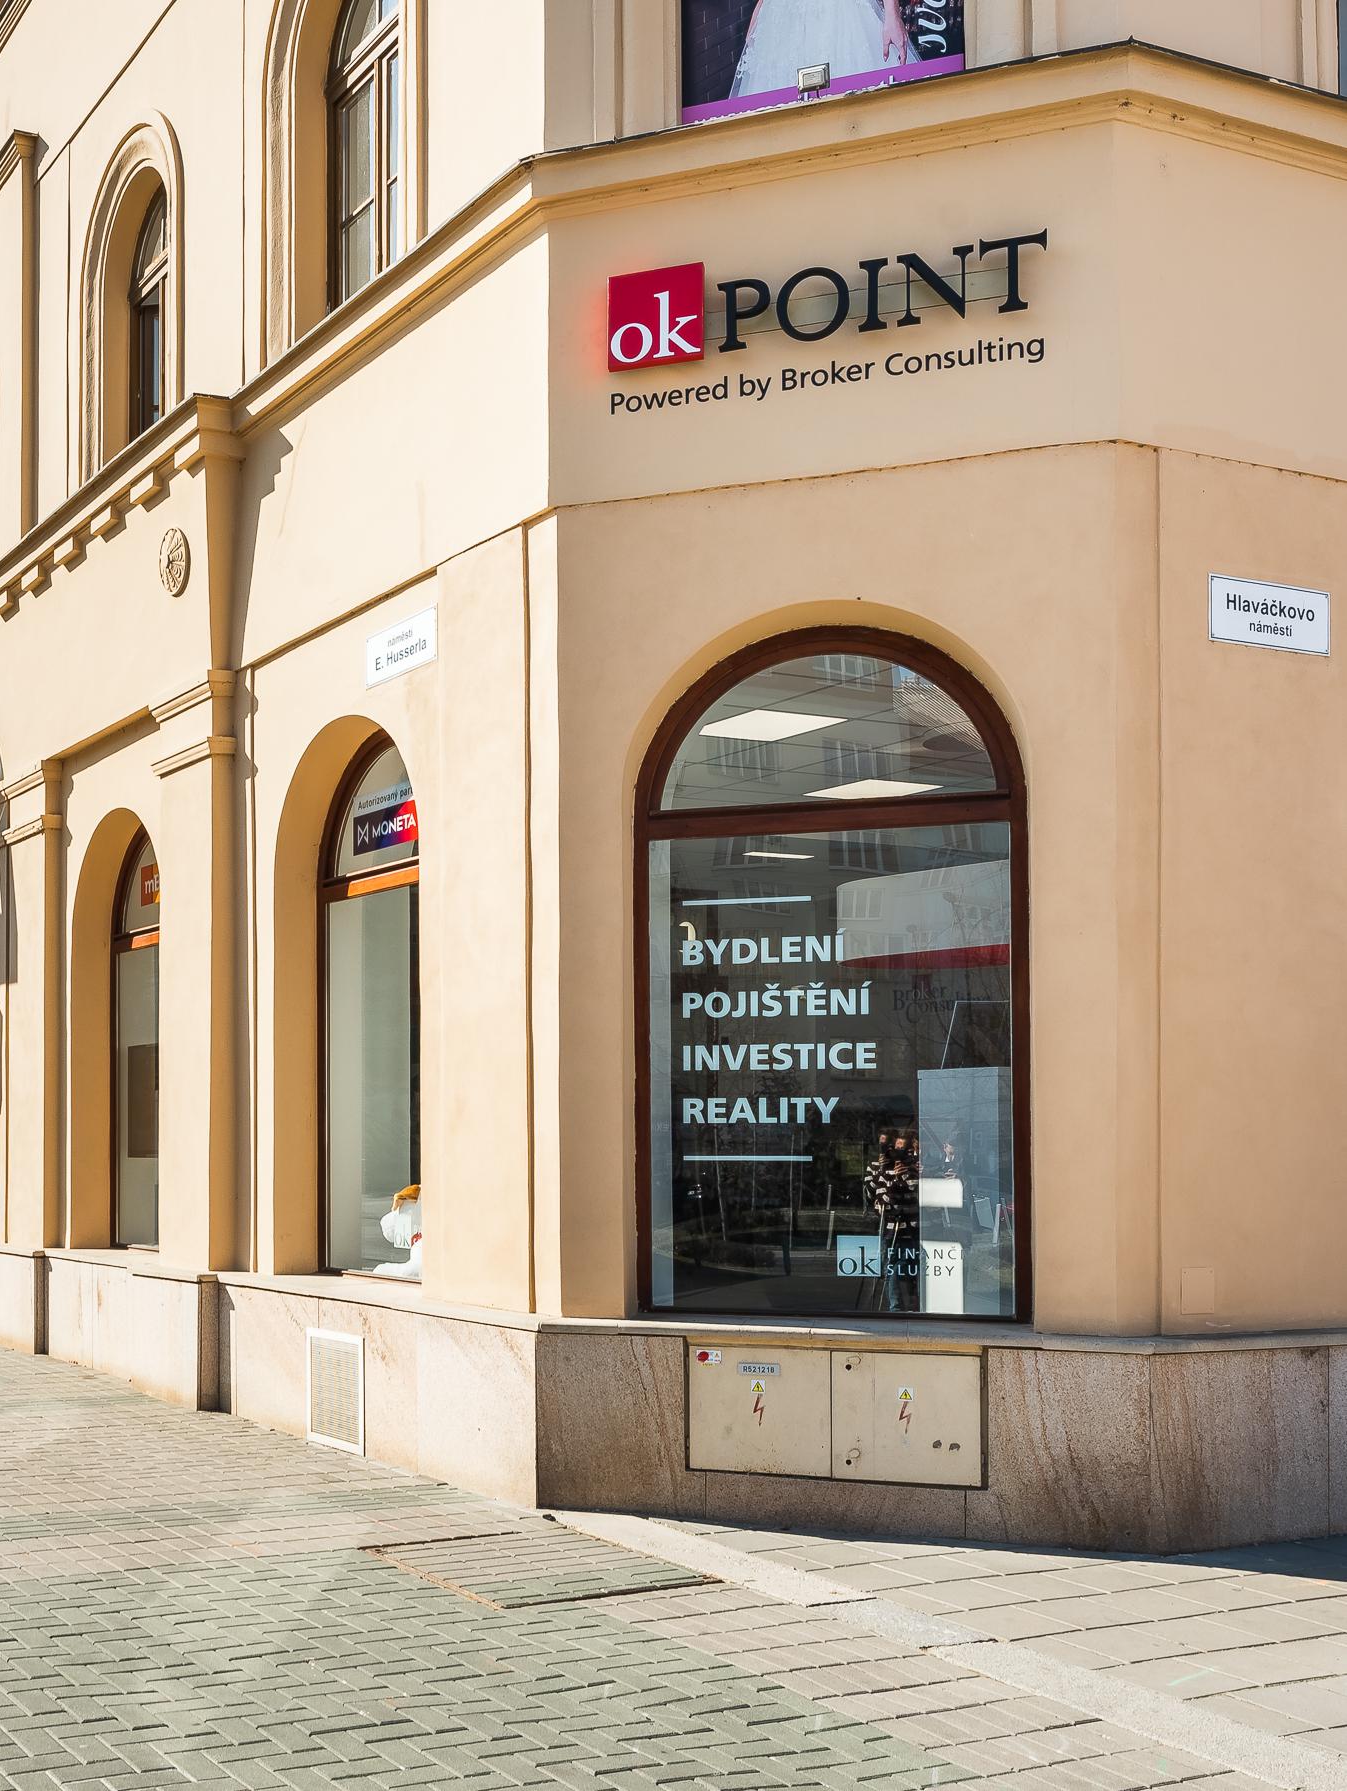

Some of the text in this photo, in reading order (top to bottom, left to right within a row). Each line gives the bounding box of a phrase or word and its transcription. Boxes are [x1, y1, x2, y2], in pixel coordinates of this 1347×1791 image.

[610, 227, 1047, 363] ok POINT
[610, 336, 1045, 415] Powered by Broker Consulting
[1226, 592, 1315, 622] Hlaváčkovo
[1249, 620, 1293, 637] náměstí
[375, 638, 427, 671] E. Husserla
[357, 790, 398, 811] Autorizovaný
[372, 813, 417, 839] MONETA
[682, 927, 847, 966] BYDLENÍ
[682, 980, 873, 1019] POJIŠTĚNÍ
[682, 1042, 877, 1072] INVESTICE
[682, 1096, 840, 1124] REALITY
[838, 1245, 880, 1276] ok
